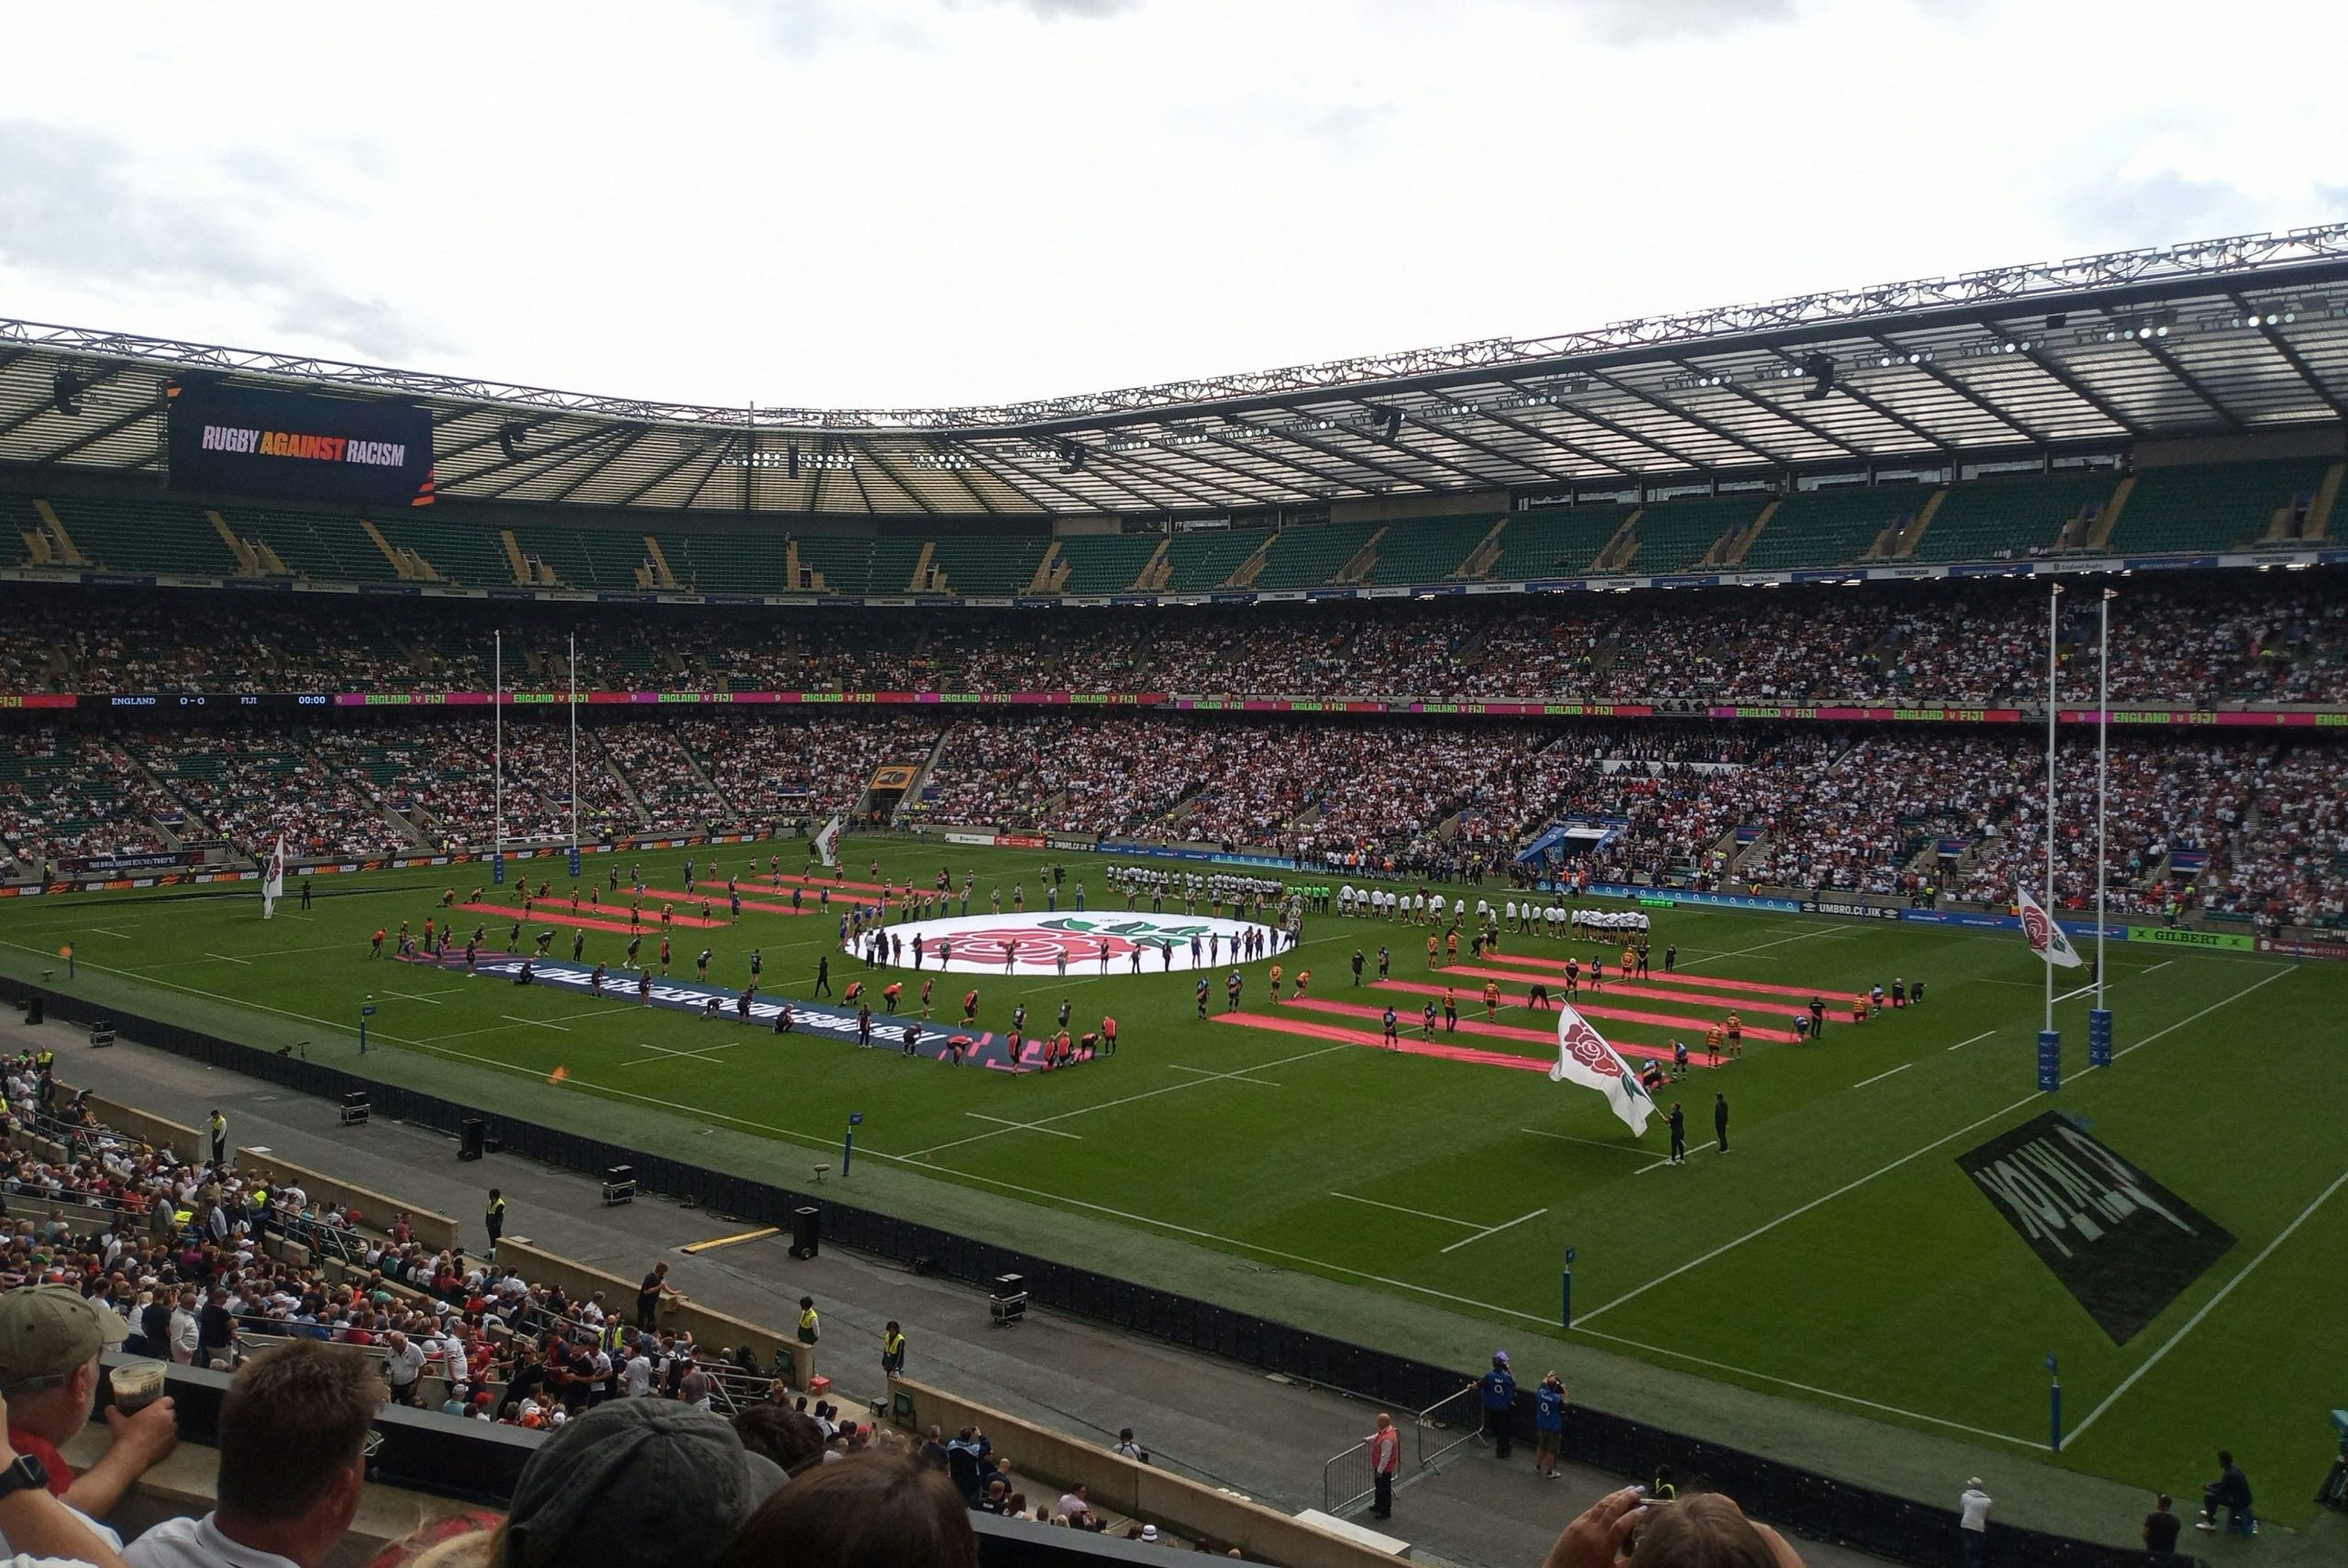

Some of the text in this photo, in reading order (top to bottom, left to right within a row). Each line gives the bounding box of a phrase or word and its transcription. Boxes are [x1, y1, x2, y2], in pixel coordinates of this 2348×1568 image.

[202, 425, 405, 467] RUGBY AGAINST RACISM
[111, 697, 156, 705] ENGLAND
[366, 694, 411, 704] ENGLAND
[425, 694, 446, 704] FIJI
[514, 693, 554, 703] ENGLAND
[569, 693, 588, 703] FIJI
[659, 693, 700, 703] ENGLAND
[713, 693, 734, 703] FIJI
[802, 693, 843, 702] ENGLAND
[856, 693, 875, 702] FIJI
[940, 694, 980, 703] ENGLAND
[993, 694, 1012, 703] FIJI
[1070, 694, 1108, 703] ENGLAND
[1120, 694, 1137, 703] FIJI
[1193, 701, 1222, 710] ENGLAND
[1230, 701, 1244, 710] FIJI
[1291, 702, 1323, 711] ENGLAND
[1332, 702, 1346, 711] FIJI
[1423, 703, 1457, 713] ENGLAND
[1468, 703, 1485, 713] FIJI
[1545, 705, 1583, 715] ENGLAND
[1594, 705, 1613, 715] FIJI
[1736, 707, 1780, 718] ENGLAND
[1795, 707, 1817, 718] FIJI
[1893, 710, 1944, 721] ENGLAND
[1960, 710, 1984, 721] FIJI
[2113, 712, 2171, 723] ENGLAND
[2189, 712, 2217, 723] FIJI
[1819, 903, 1881, 917] UMBRO.CO.UK
[2155, 931, 2220, 945] GILBERT
[1974, 1137, 2139, 1258] TikTok
